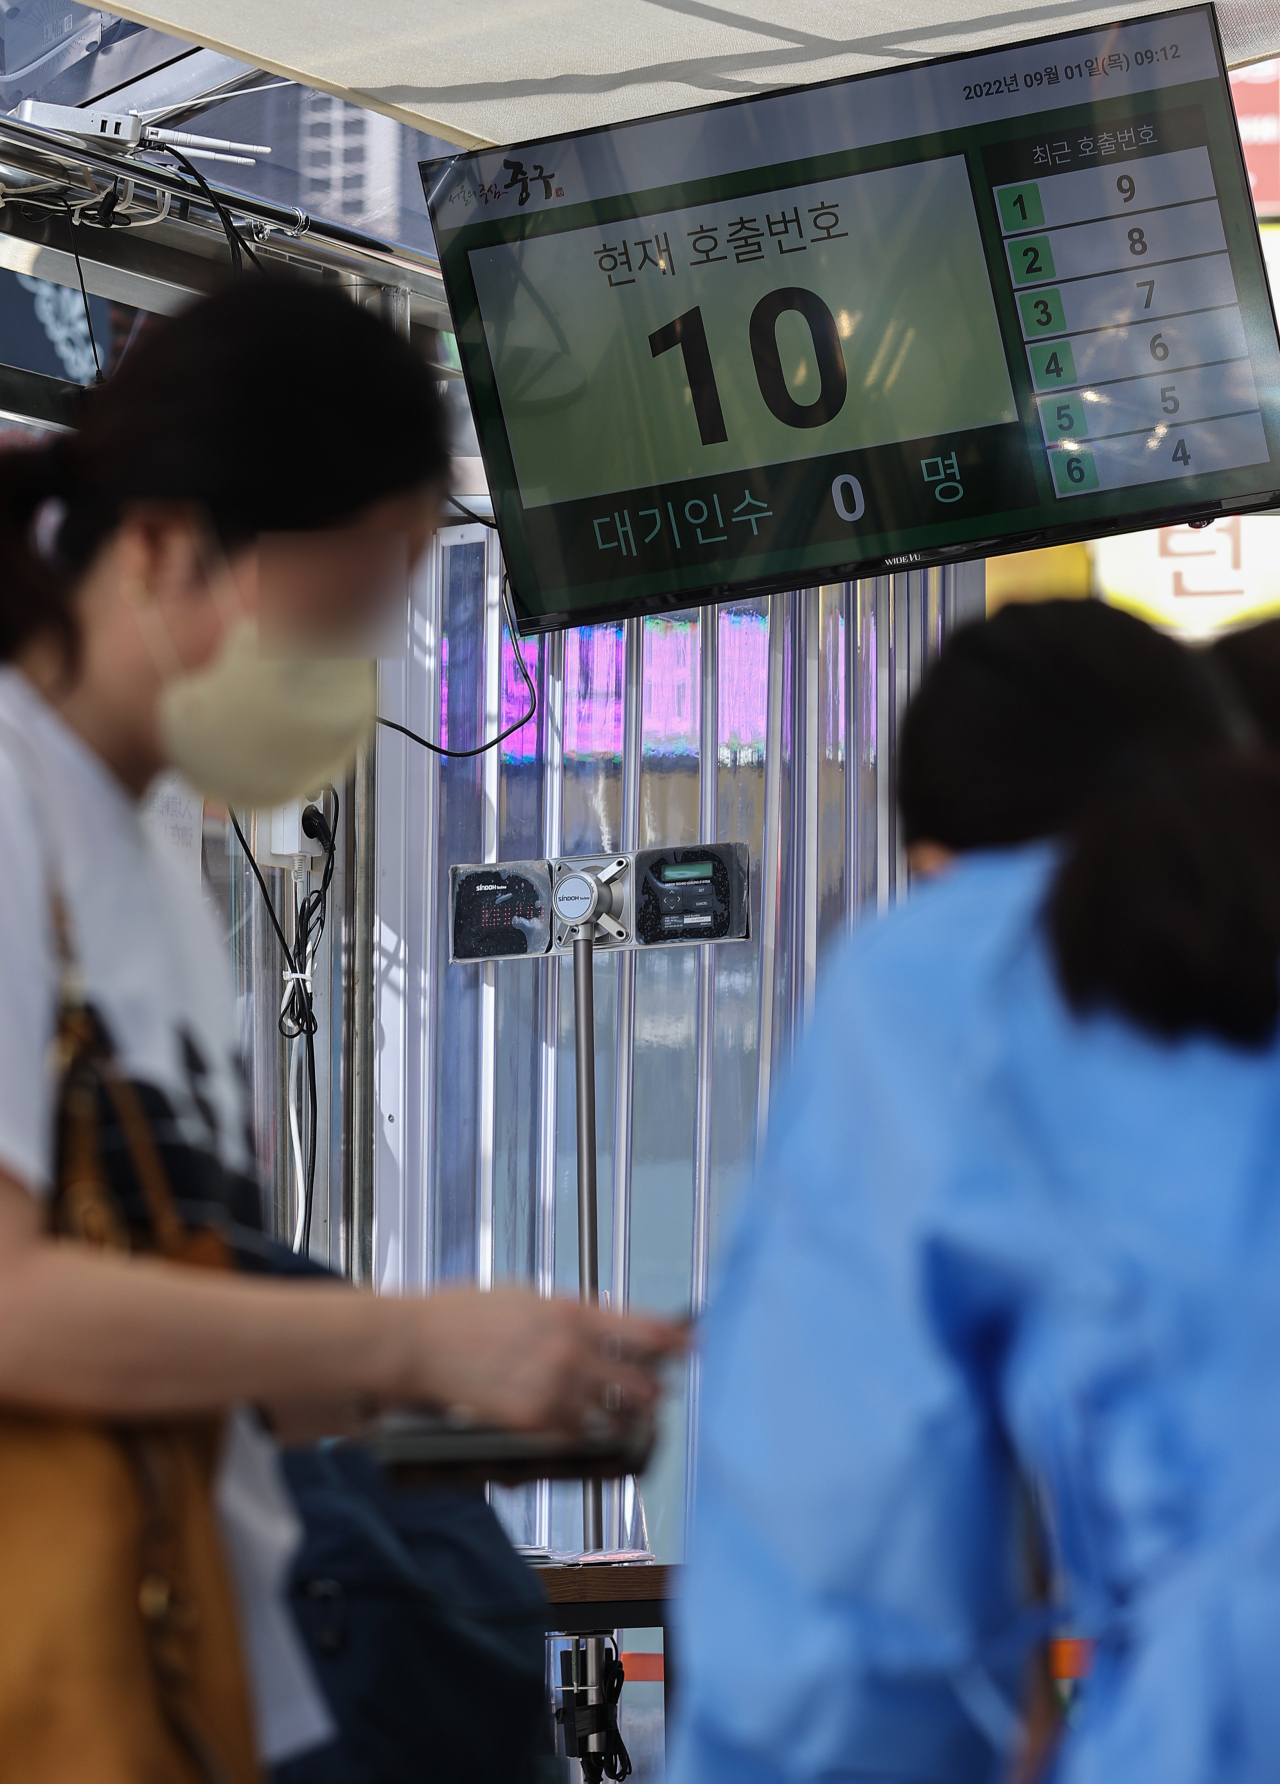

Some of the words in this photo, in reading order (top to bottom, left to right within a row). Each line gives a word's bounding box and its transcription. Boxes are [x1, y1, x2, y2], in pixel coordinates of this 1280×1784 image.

[962, 73, 1020, 100] 2022년
[1023, 65, 1061, 88] 09월
[1064, 53, 1130, 79] 01일(목)
[1134, 44, 1182, 67] 09:12
[1032, 141, 1072, 165] 최근
[1078, 124, 1158, 156] 호출번호
[503, 159, 555, 207] 중구
[1012, 194, 1029, 222] 1
[1116, 174, 1136, 203] 9
[593, 231, 676, 287] 현재
[688, 201, 849, 267] 호출번호
[1022, 246, 1042, 274] 2
[1127, 227, 1148, 256] 8
[1032, 298, 1053, 327] 3
[1136, 280, 1155, 309] 7
[648, 286, 848, 445] 10
[1043, 351, 1064, 379] 4
[1149, 332, 1169, 362] 6
[1055, 403, 1074, 432] 5
[1160, 384, 1180, 415] 5
[1065, 456, 1085, 484] 6
[1171, 438, 1191, 467] 4
[592, 489, 774, 558] 대기인수
[831, 473, 866, 522] 0
[920, 451, 964, 504] 명
